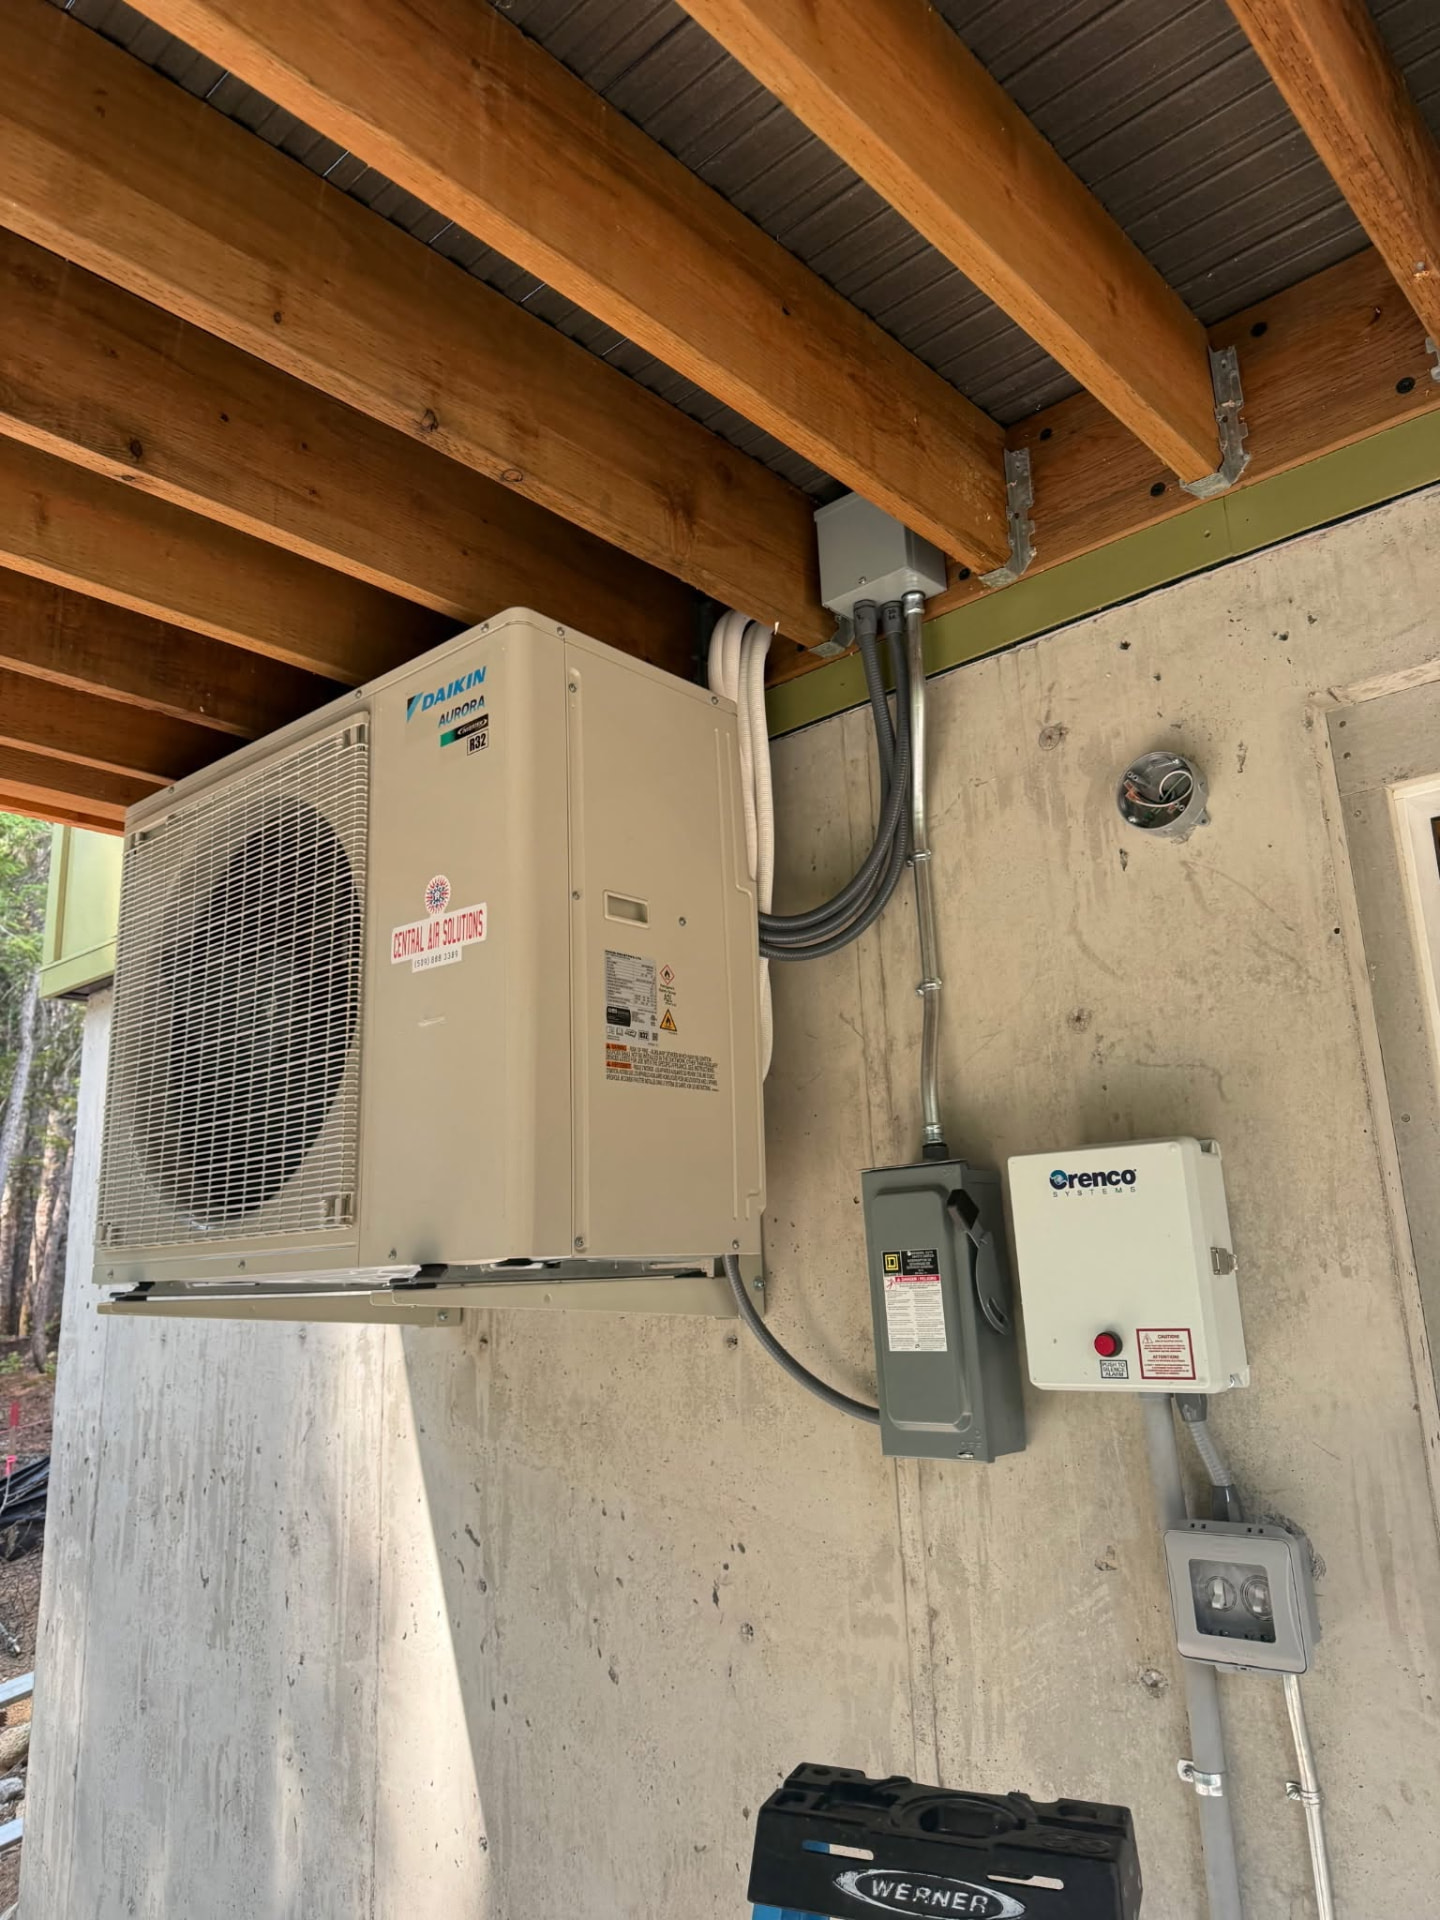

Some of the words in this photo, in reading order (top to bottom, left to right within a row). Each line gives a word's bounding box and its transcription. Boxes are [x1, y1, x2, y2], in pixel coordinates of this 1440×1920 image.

[421, 665, 486, 712] DAIKIN
[438, 694, 486, 728] AURORA
[469, 732, 487, 752] R32
[393, 925, 424, 959] CENTRAL
[428, 921, 440, 950] AIR
[442, 909, 484, 946] SOLUTIONS
[1049, 1168, 1136, 1190] Orenco
[1052, 1186, 1136, 1198] SYSTEMS
[871, 1878, 989, 1914] WERNER
